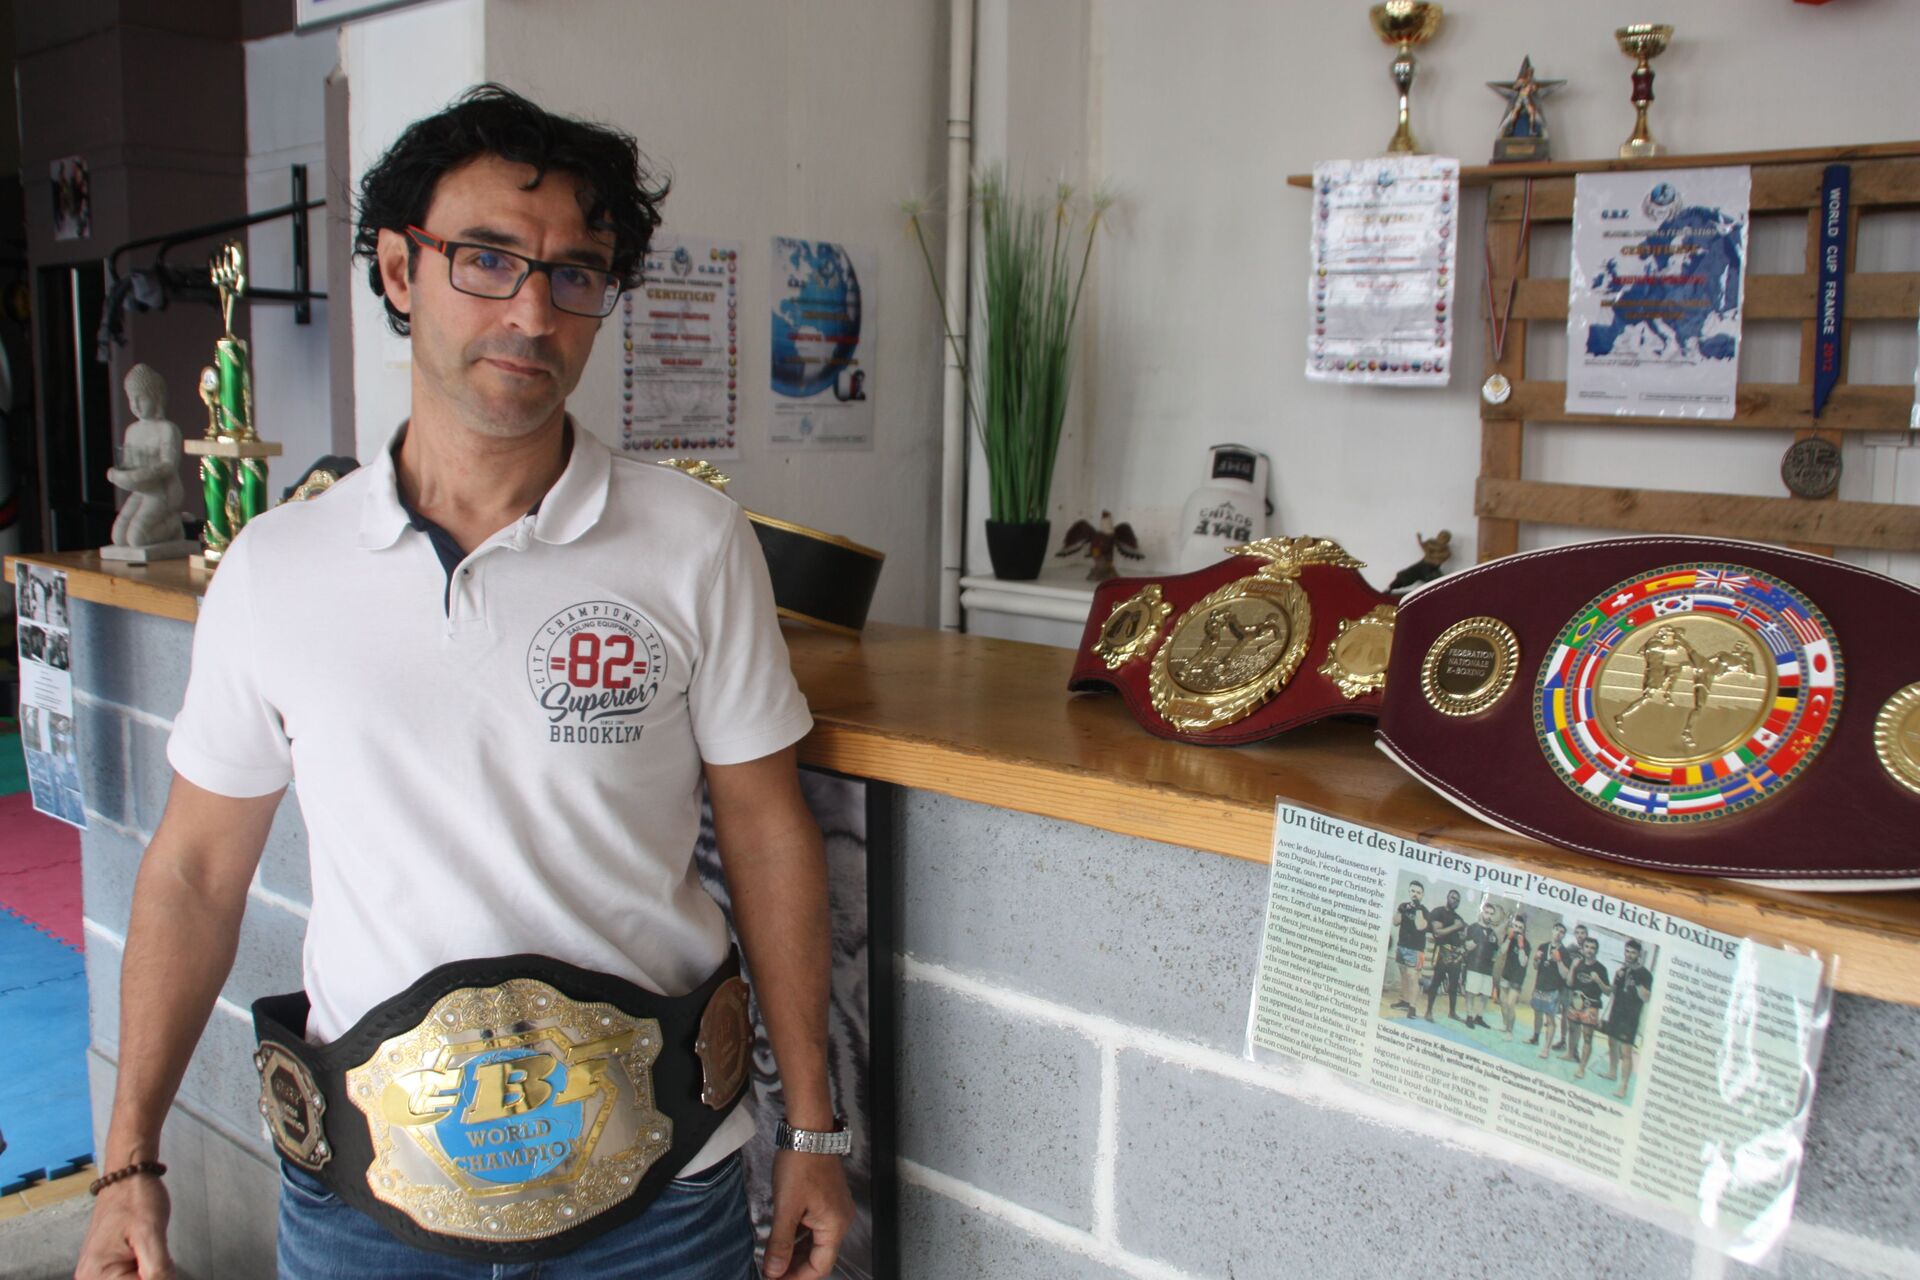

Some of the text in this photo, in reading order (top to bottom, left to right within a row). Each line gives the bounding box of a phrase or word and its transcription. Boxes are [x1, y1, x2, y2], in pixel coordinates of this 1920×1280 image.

[1827, 187, 1841, 237] WORLD
[1826, 245, 1838, 273] CUP
[1823, 281, 1836, 335] FRANCE
[546, 606, 641, 636] CHAMPIONS
[646, 633, 661, 673] TEAM
[566, 620, 637, 638] SAILING EQUIPMENT
[568, 632, 635, 689] 82
[1448, 648, 1495, 659] FEDERATION
[540, 682, 658, 723] Superior
[550, 725, 644, 744] BROOKLYN
[1277, 850, 1289, 858] son
[1318, 860, 1341, 874] l'école
[1353, 873, 1376, 884] centre
[1278, 838, 1294, 849] Avec
[1302, 845, 1315, 855] duo
[1316, 849, 1334, 861] Jules
[1335, 854, 1369, 871] Gaussens
[1274, 869, 1316, 889] Ambrosiano
[1328, 888, 1366, 903] septembre
[1280, 807, 1740, 961] Un titre et des lauriers pour l'école de kick boxing
[1303, 869, 1329, 881] ouverte
[1330, 877, 1342, 885] par
[1344, 879, 1384, 898] Christophe
[1270, 901, 1292, 914] Totem
[1317, 915, 1347, 933] Monthey
[1290, 896, 1305, 907] Lors
[1305, 901, 1321, 912] d'un
[1321, 908, 1336, 917] gala
[1336, 912, 1367, 926] organisé
[1367, 922, 1380, 930] par
[1296, 888, 1319, 900] récolté
[1321, 896, 1332, 904] ses
[1332, 900, 1366, 915] premiers
[1268, 921, 1295, 936] d'Olmes
[1296, 932, 1307, 940] ont
[1307, 936, 1339, 951] remporté
[1339, 944, 1357, 956] leurs
[1269, 911, 1279, 921] les
[1281, 915, 1298, 927] deux
[1298, 923, 1323, 935] jeunes
[1324, 929, 1347, 942] élèves
[1359, 942, 1377, 952] pays
[1265, 944, 1289, 957] cipline
[1290, 951, 1306, 962] boxe
[1266, 932, 1281, 943] bats
[1285, 938, 1302, 950] leurs
[1303, 946, 1334, 960] premiers
[1335, 954, 1352, 966] dans
[1273, 966, 1302, 982] donnant
[1312, 981, 1332, 992] qu'ils
[1333, 988, 1370, 1005] pouvaient
[1278, 958, 1289, 966] ont
[1289, 962, 1310, 973] relevé
[1311, 967, 1325, 978] leur
[1326, 974, 1354, 988] premier
[1269, 999, 1296, 1012] apprend
[1296, 1006, 1312, 1018] dans
[1350, 1027, 1366, 1037] vaut
[1299, 988, 1329, 1002] souligné
[1329, 996, 1368, 1016] Christophe
[1304, 998, 1318, 1009] leur
[1258, 1005, 1280, 1017] mieux
[1281, 1013, 1304, 1025] quand
[1305, 1022, 1328, 1034] même
[1255, 1024, 1295, 1044] Ambrosiano
[1300, 1039, 1311, 1050] fait
[1312, 1043, 1347, 1062] également
[1348, 1056, 1361, 1067] lors
[1263, 1039, 1275, 1047] son
[1276, 1043, 1301, 1056] combat
[1301, 1052, 1348, 1074] professionnel
[1284, 1025, 1300, 1035] c'est
[1309, 1034, 1322, 1043] que
[1323, 1037, 1362, 1057] Christophe
[1377, 1023, 1495, 1069] L'école du centre K-Boxing avec son
[465, 1119, 551, 1147] WORLD
[451, 1136, 585, 1174] CHAMPION
